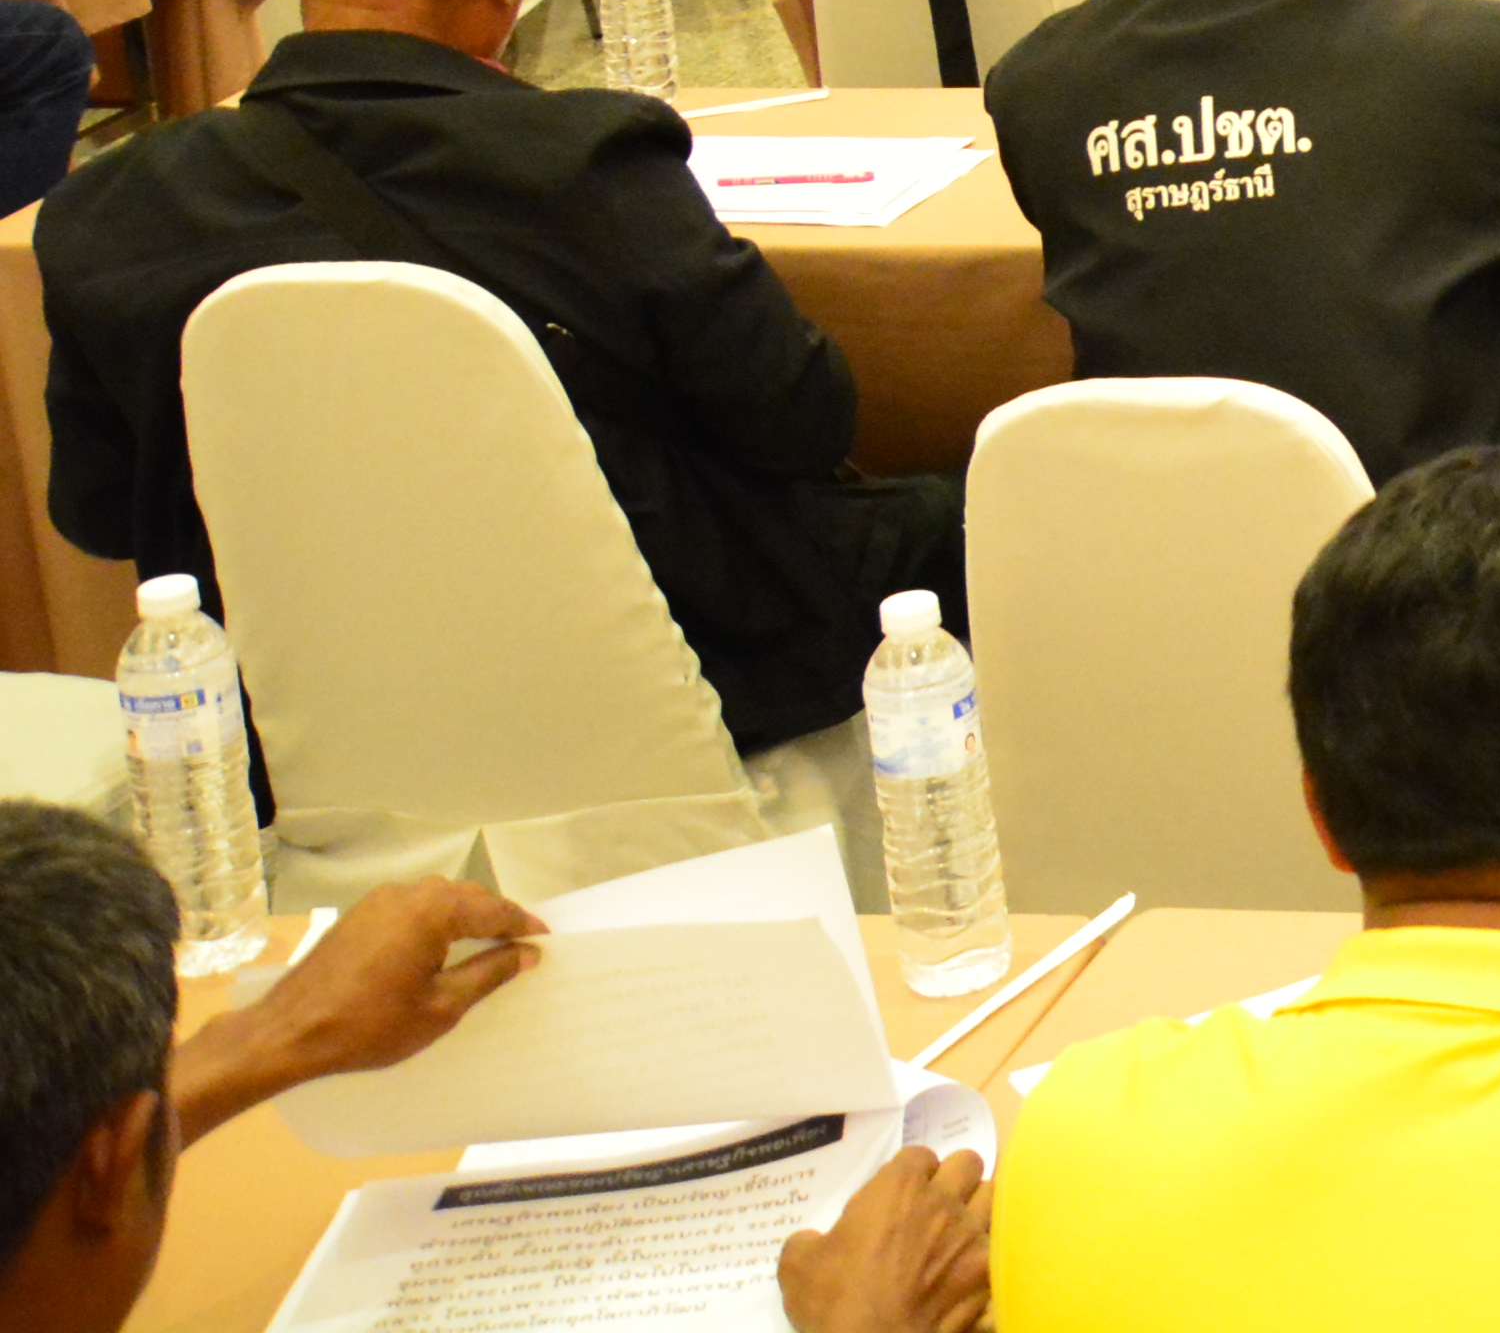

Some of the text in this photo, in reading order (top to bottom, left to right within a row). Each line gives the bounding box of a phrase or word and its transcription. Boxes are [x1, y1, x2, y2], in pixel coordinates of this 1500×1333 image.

[1086, 95, 1313, 176] ศส.ปชต.
[1124, 163, 1275, 221] สุราษฎร์ธานี
